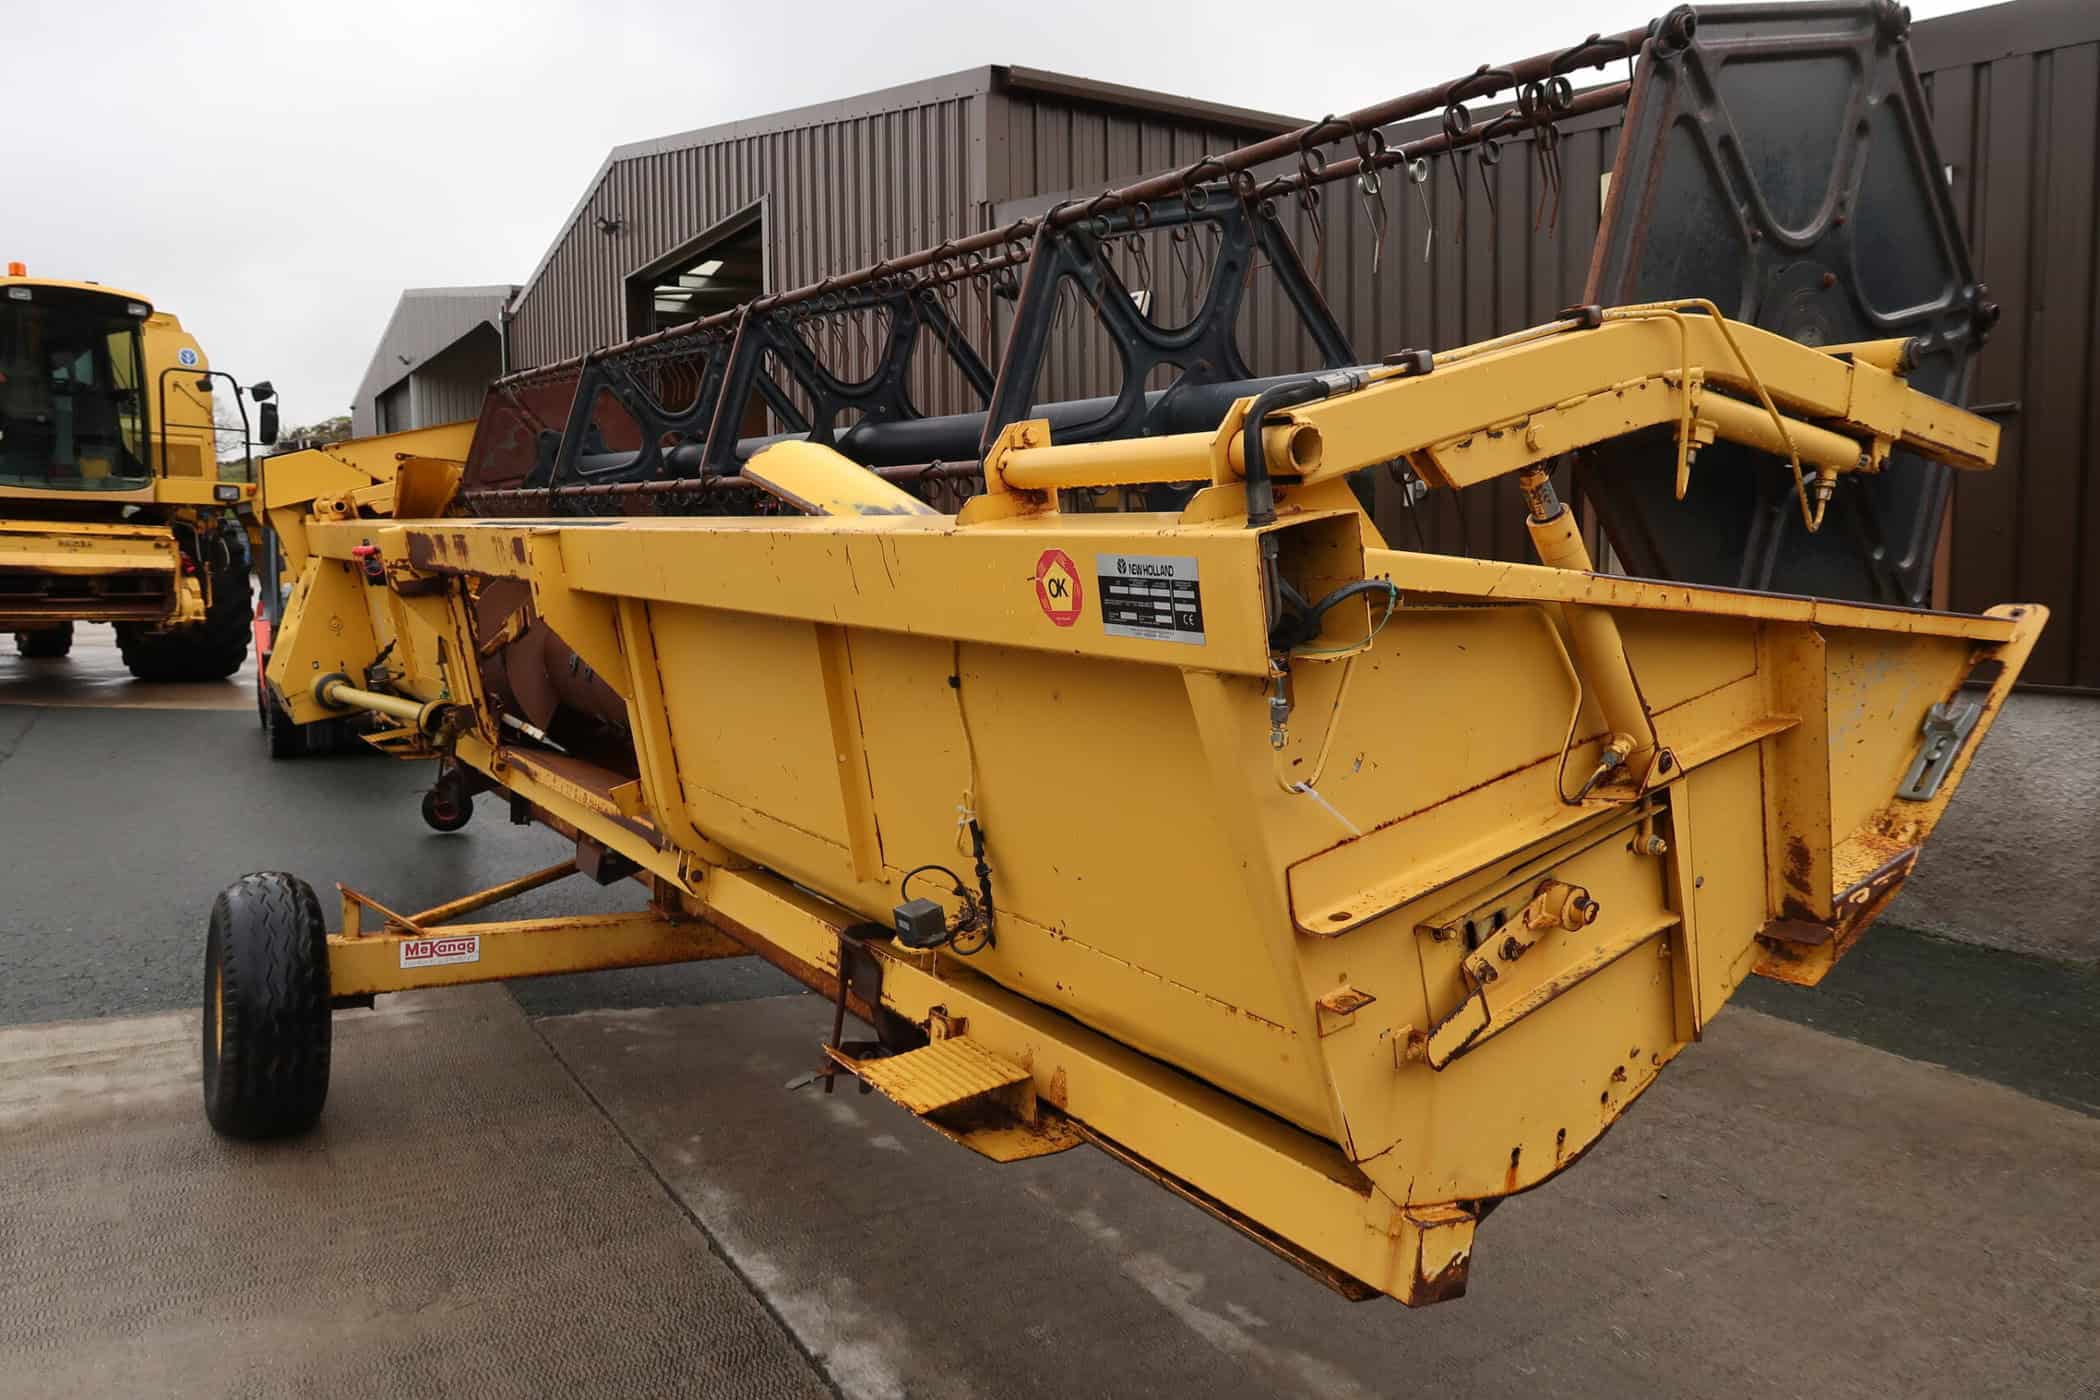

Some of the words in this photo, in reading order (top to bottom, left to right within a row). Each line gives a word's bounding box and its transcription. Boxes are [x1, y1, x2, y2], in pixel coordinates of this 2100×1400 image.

[1129, 563, 1142, 576] NEW
[1143, 564, 1175, 577] HOLLAND
[1048, 578, 1069, 598] OK
